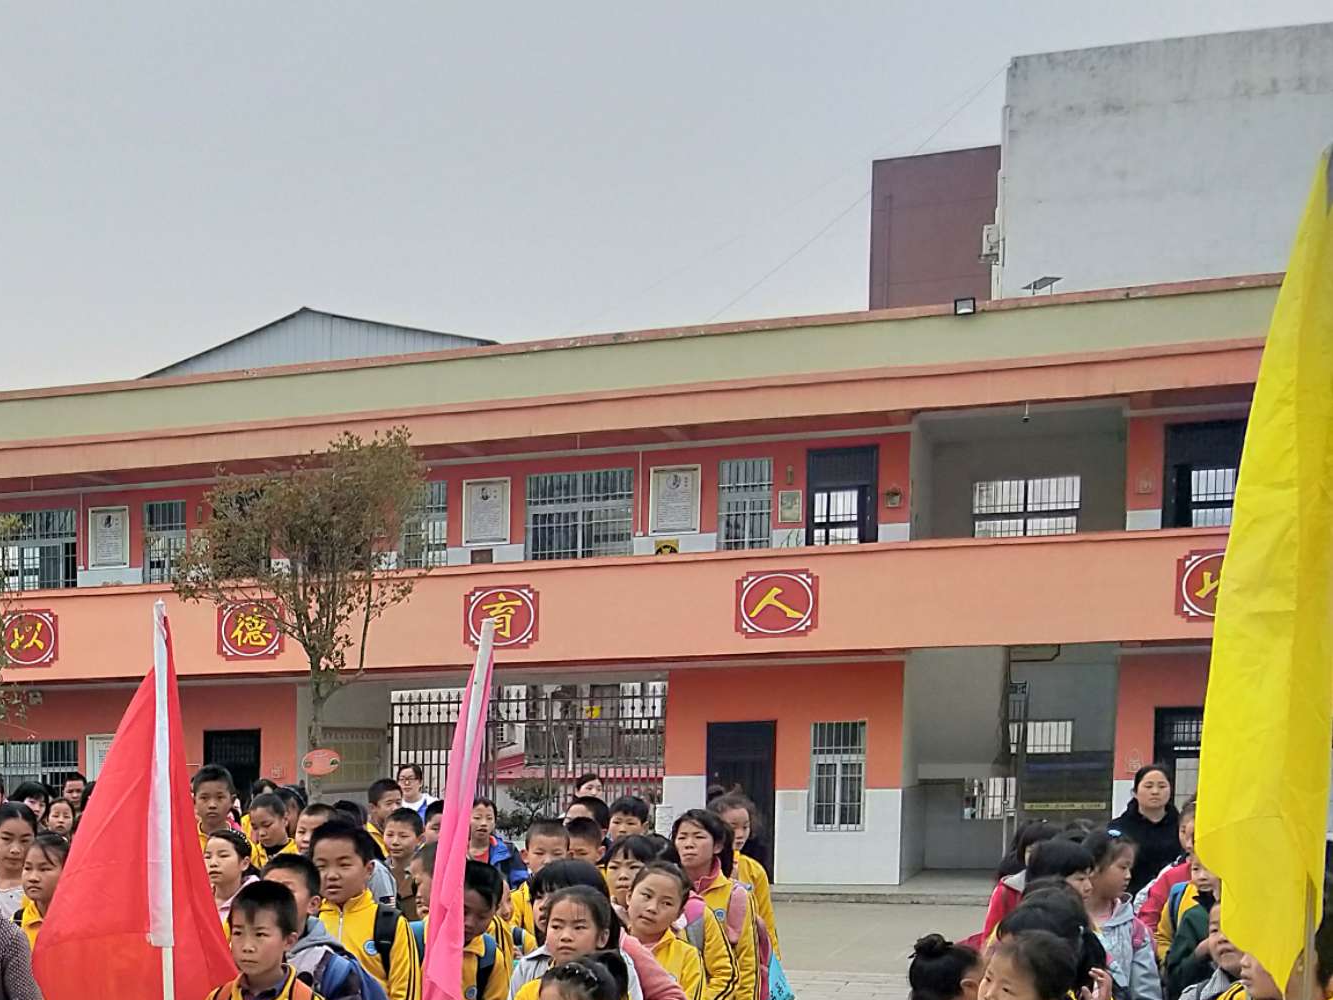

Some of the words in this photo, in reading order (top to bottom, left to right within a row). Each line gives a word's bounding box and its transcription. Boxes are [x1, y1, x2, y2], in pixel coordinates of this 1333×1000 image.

[10, 622, 44, 650] 以
[231, 608, 273, 647] 德
[481, 592, 523, 639] 育
[749, 587, 804, 618] 人
